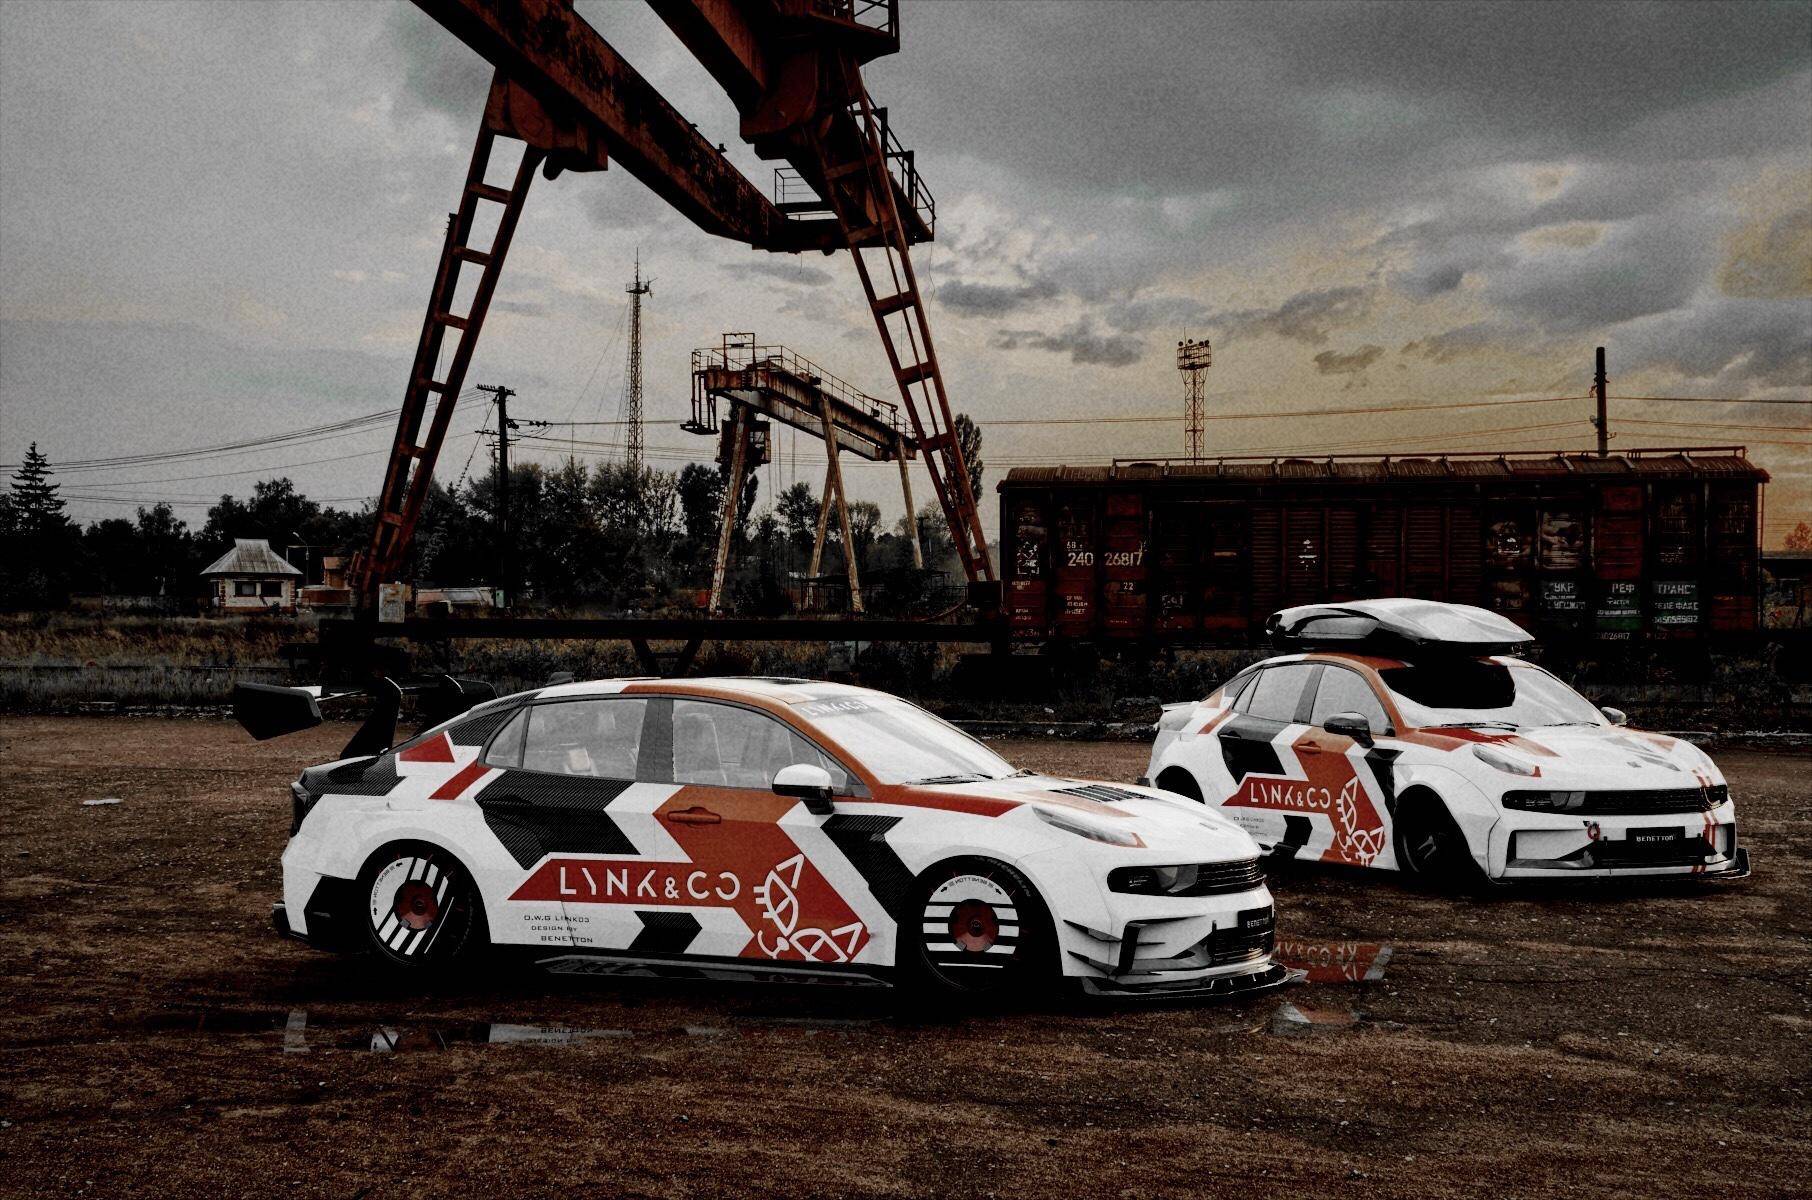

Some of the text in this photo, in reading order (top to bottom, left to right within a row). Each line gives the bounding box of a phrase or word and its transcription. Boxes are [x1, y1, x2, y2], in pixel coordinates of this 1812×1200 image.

[1067, 551, 1143, 567] 240 26817
[560, 866, 741, 901] LYNK&CO
[540, 935, 593, 943] BENETTON
